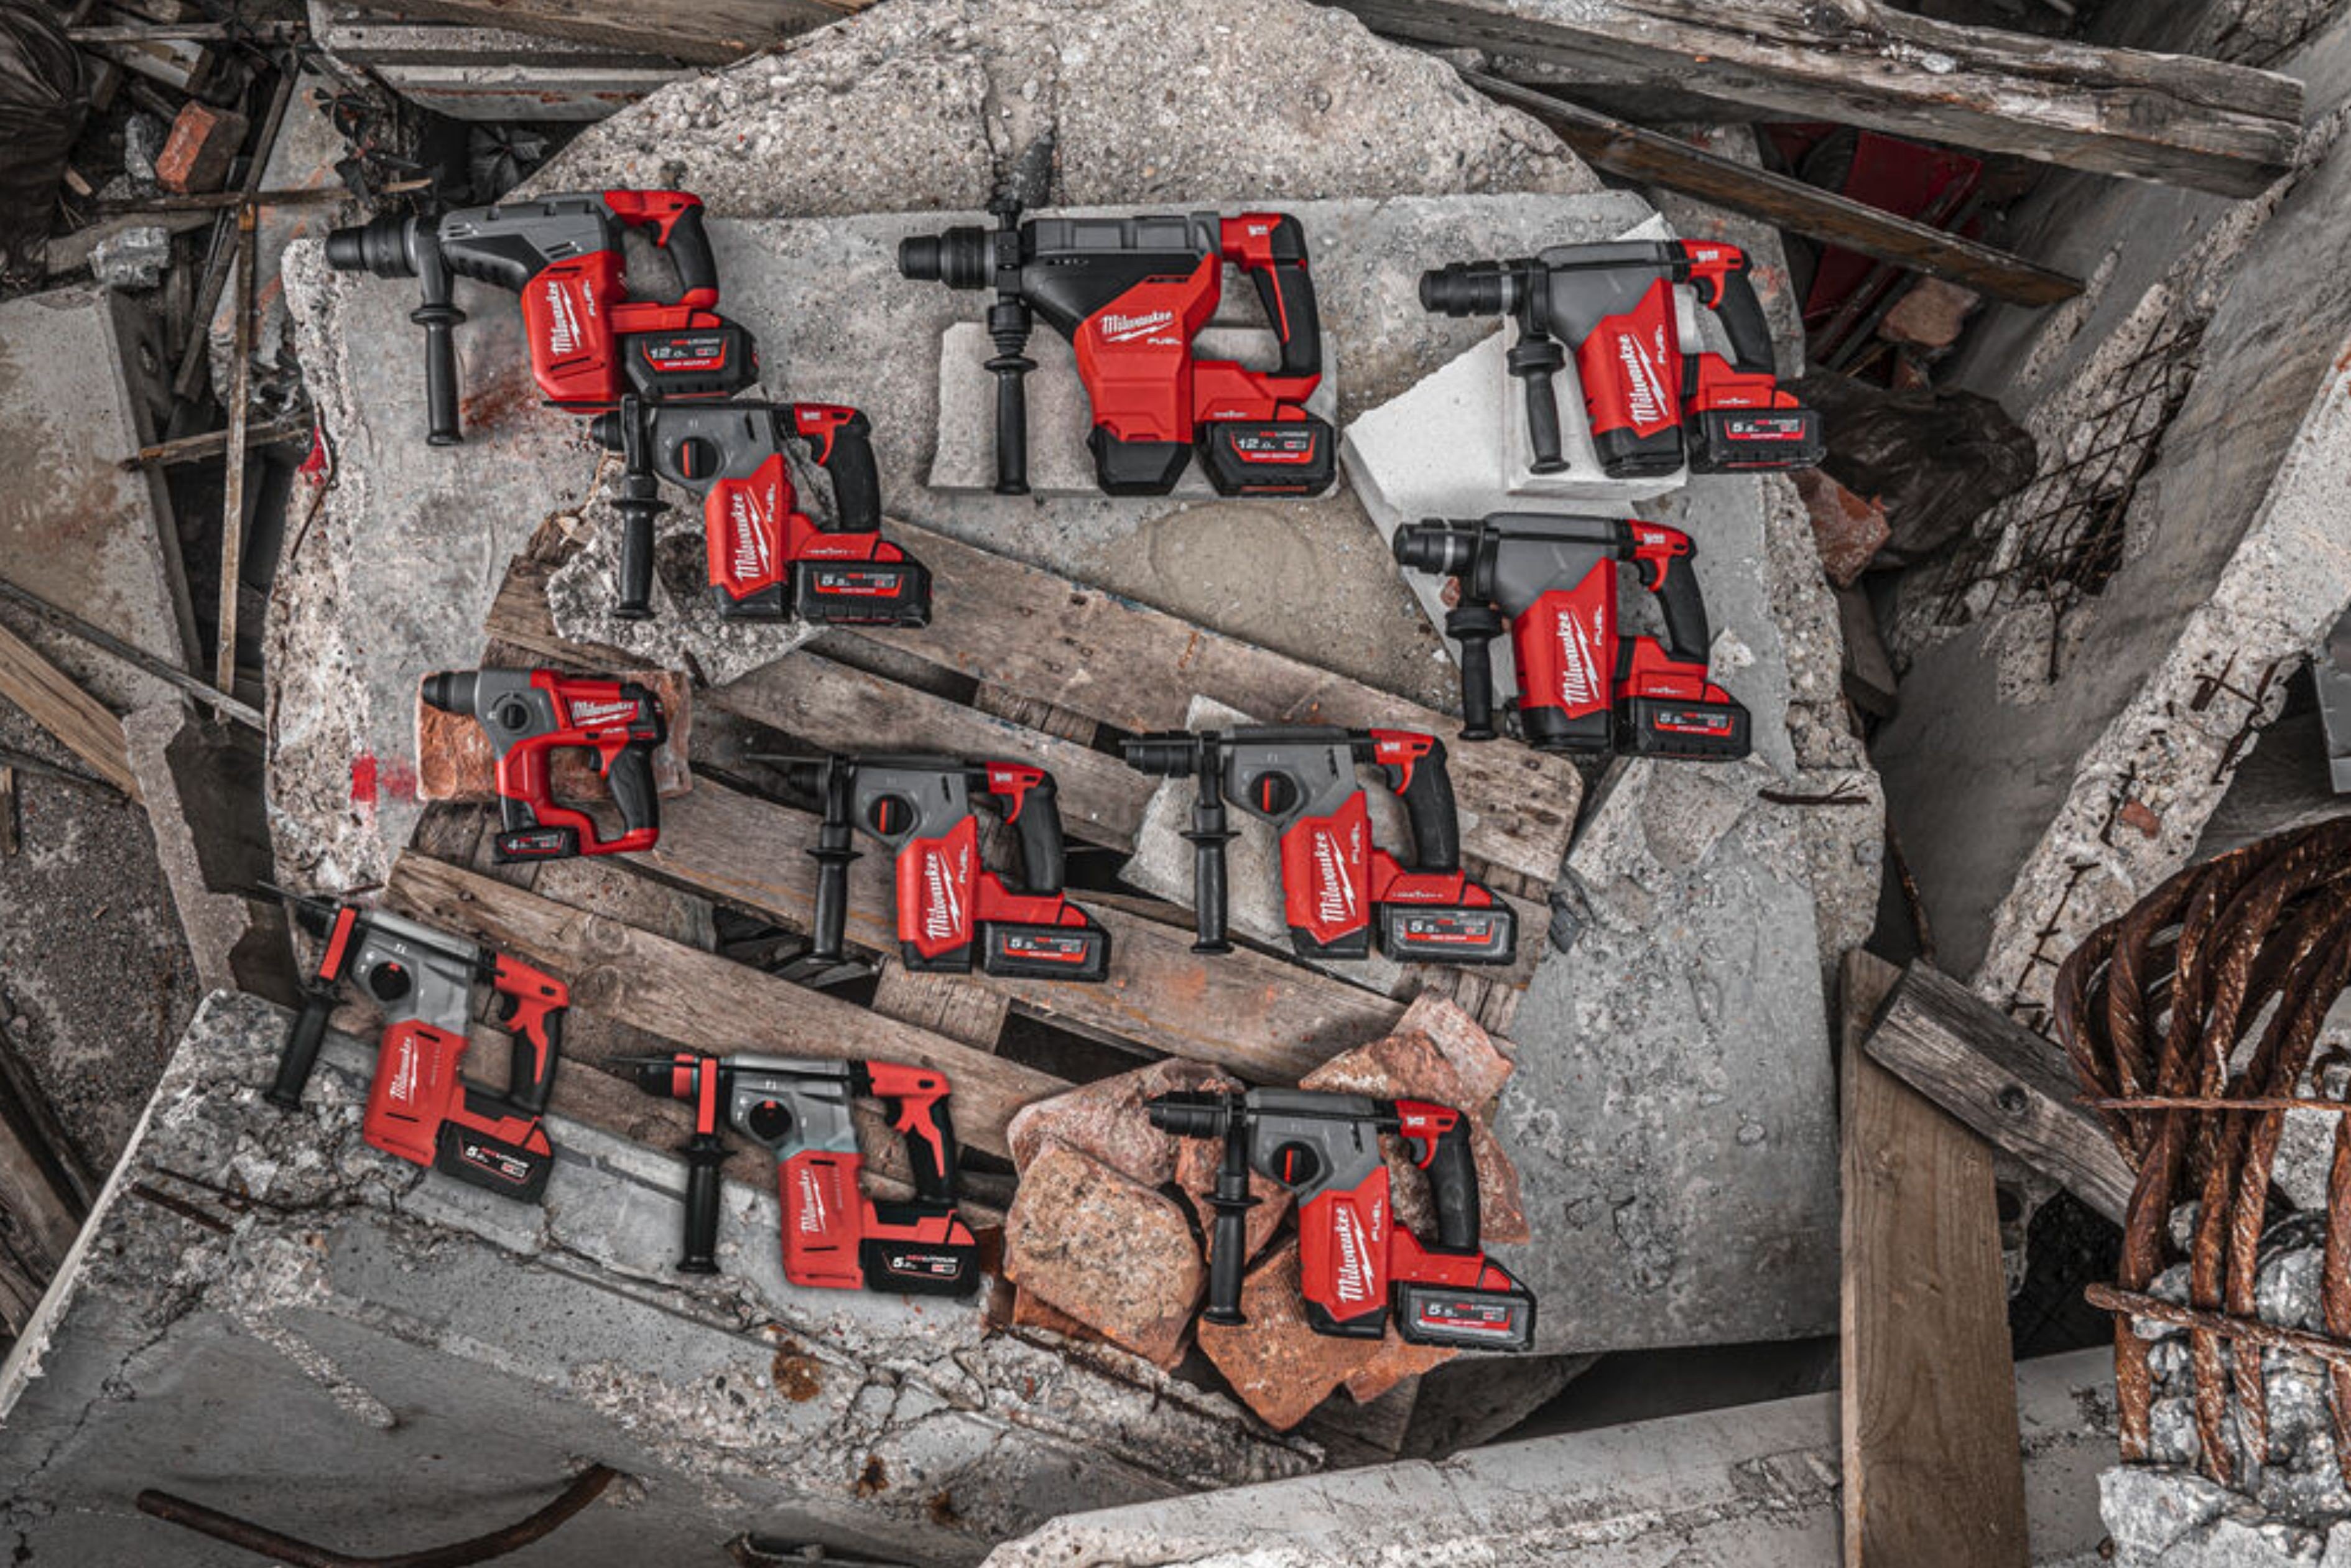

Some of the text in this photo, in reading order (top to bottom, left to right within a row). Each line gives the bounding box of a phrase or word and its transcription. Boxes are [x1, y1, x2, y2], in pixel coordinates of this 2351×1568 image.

[1101, 311, 1173, 334] Milwaukee
[1618, 334, 1659, 427] Milwaukee
[730, 493, 760, 581] Milwaukee
[1556, 611, 1590, 707] Milwaukee
[925, 853, 951, 940] Milwaukee
[1315, 832, 1346, 922] Milwaukee
[1335, 1207, 1363, 1302] Milwaukee
